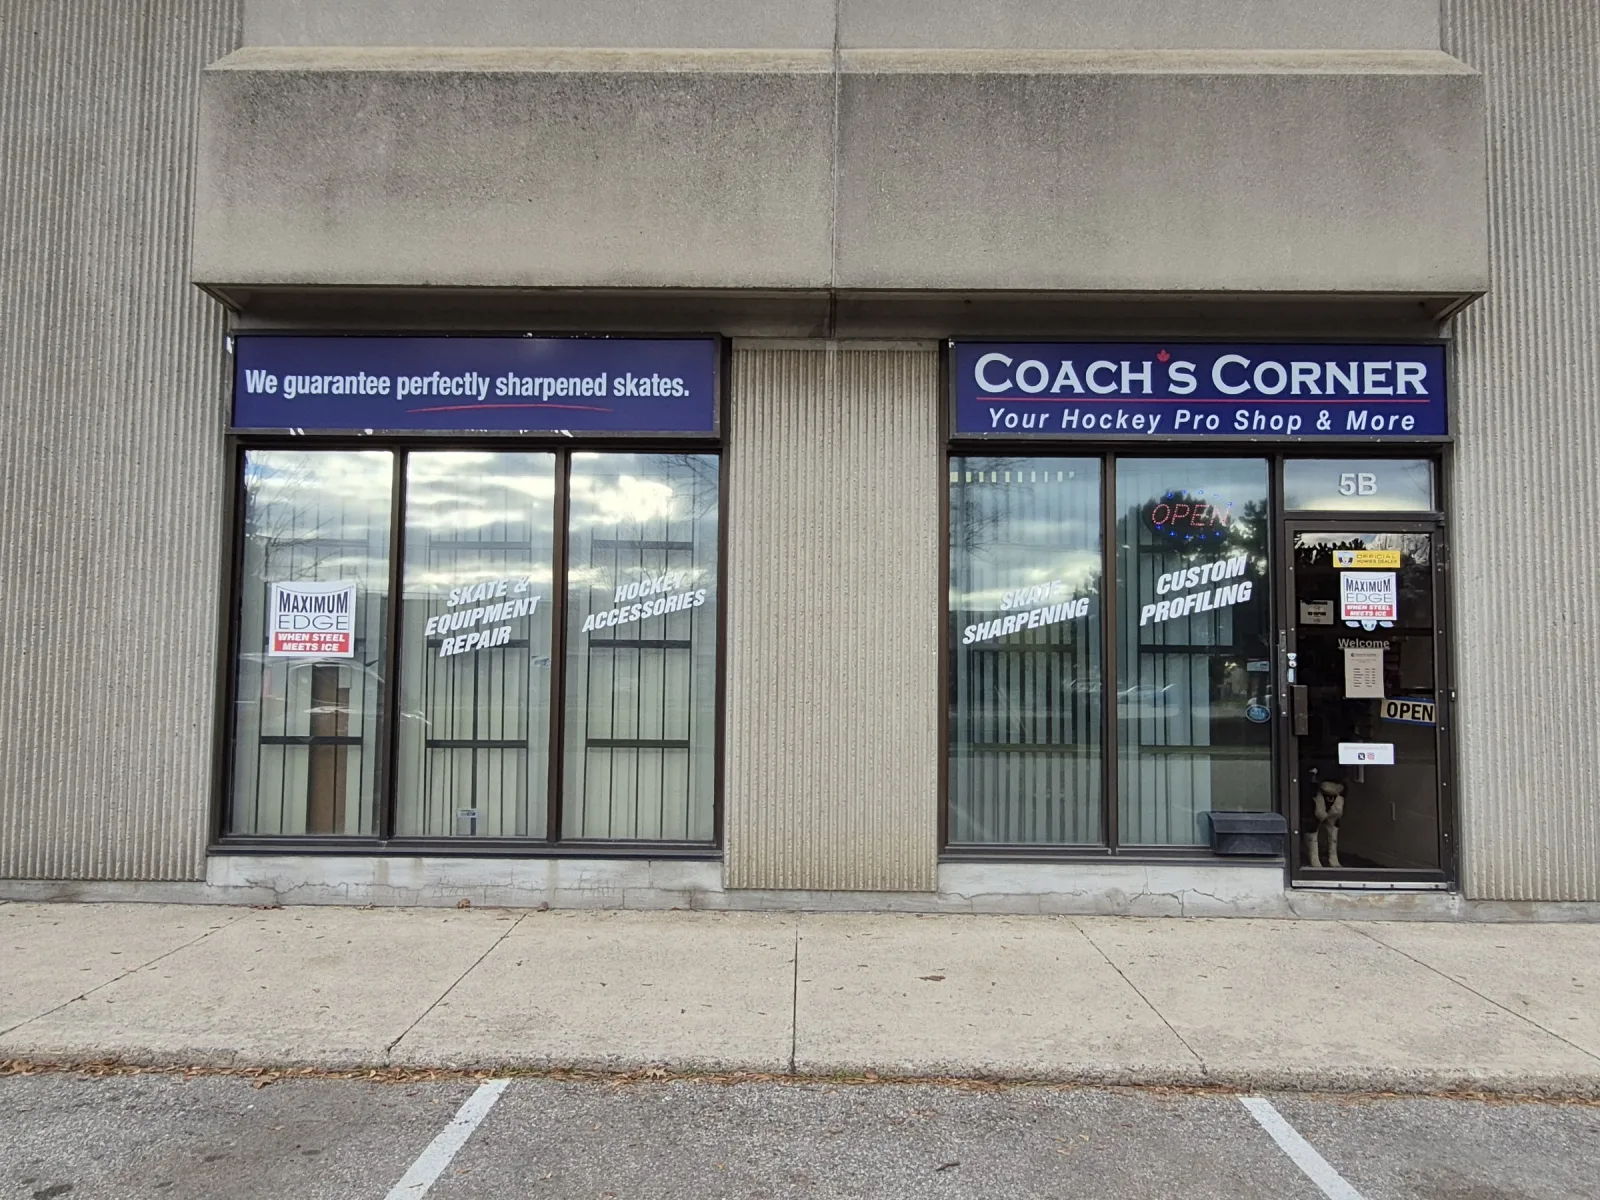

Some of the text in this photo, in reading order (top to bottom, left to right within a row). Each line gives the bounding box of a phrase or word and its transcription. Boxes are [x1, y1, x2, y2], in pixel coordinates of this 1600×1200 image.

[245, 368, 690, 401] We guarantee perfectly sharpened skates.
[1211, 353, 1429, 396] CORNER
[988, 408, 1415, 435] Your Hockey Pro Shop & More
[1338, 472, 1378, 496] 5B
[1151, 503, 1230, 527] OPEN
[614, 573, 688, 603] HOCKEY
[1156, 555, 1248, 595] CUSTOM
[1345, 577, 1391, 593] MAXIMUM
[278, 590, 349, 614] MAXIMUM
[446, 576, 531, 607] SKATE &
[1000, 579, 1062, 611] SKATE
[1139, 581, 1253, 626] PROFILING
[1346, 592, 1393, 603] EDGE
[278, 614, 349, 630] EDGE
[425, 595, 541, 637] EQUIPMENT
[582, 588, 707, 633] ACCESSORIES
[962, 597, 1090, 645] SHARPENING
[277, 632, 346, 642] WHEN STEEL
[282, 642, 339, 652] MEETS ICE
[439, 625, 512, 658] REPAIR
[1337, 638, 1390, 649] Welcome
[1386, 701, 1434, 722] OPEN
